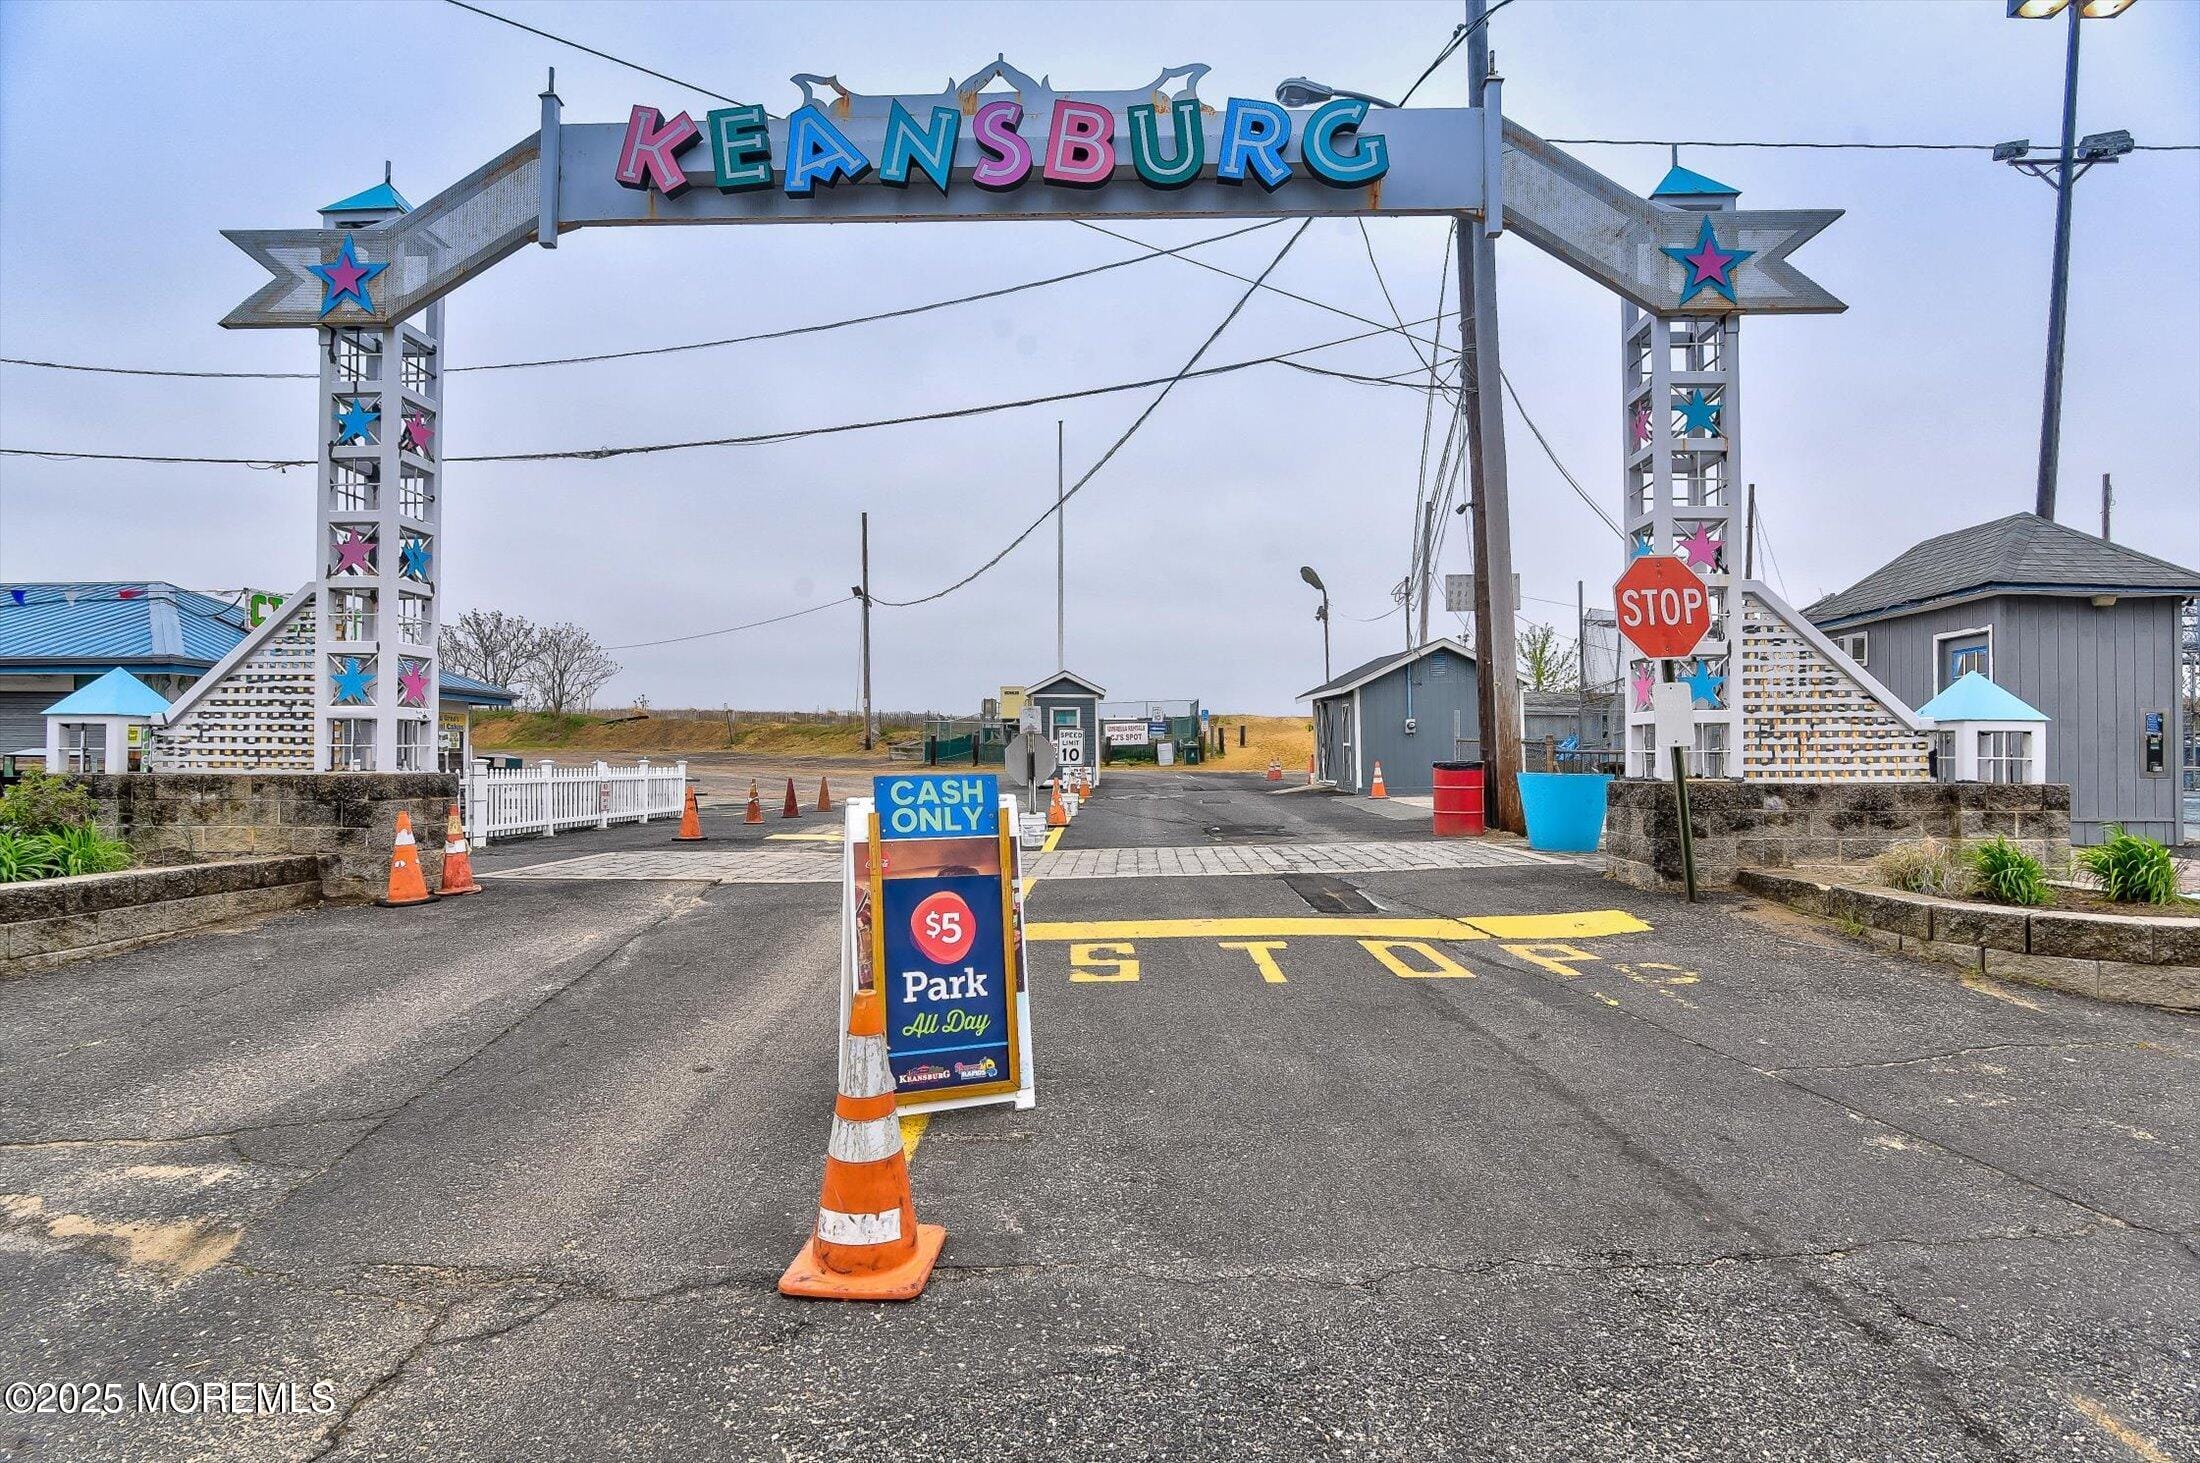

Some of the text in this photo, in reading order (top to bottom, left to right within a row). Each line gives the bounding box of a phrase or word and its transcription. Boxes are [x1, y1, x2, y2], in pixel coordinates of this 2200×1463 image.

[614, 97, 1389, 197] KEANSBURG
[1622, 588, 1703, 627] STOP
[1061, 748, 1080, 762] 10
[890, 779, 984, 806] CASH
[891, 806, 984, 833] ONLY
[925, 911, 962, 944] $5
[902, 967, 989, 1003] Park
[902, 1009, 991, 1038] All Day
